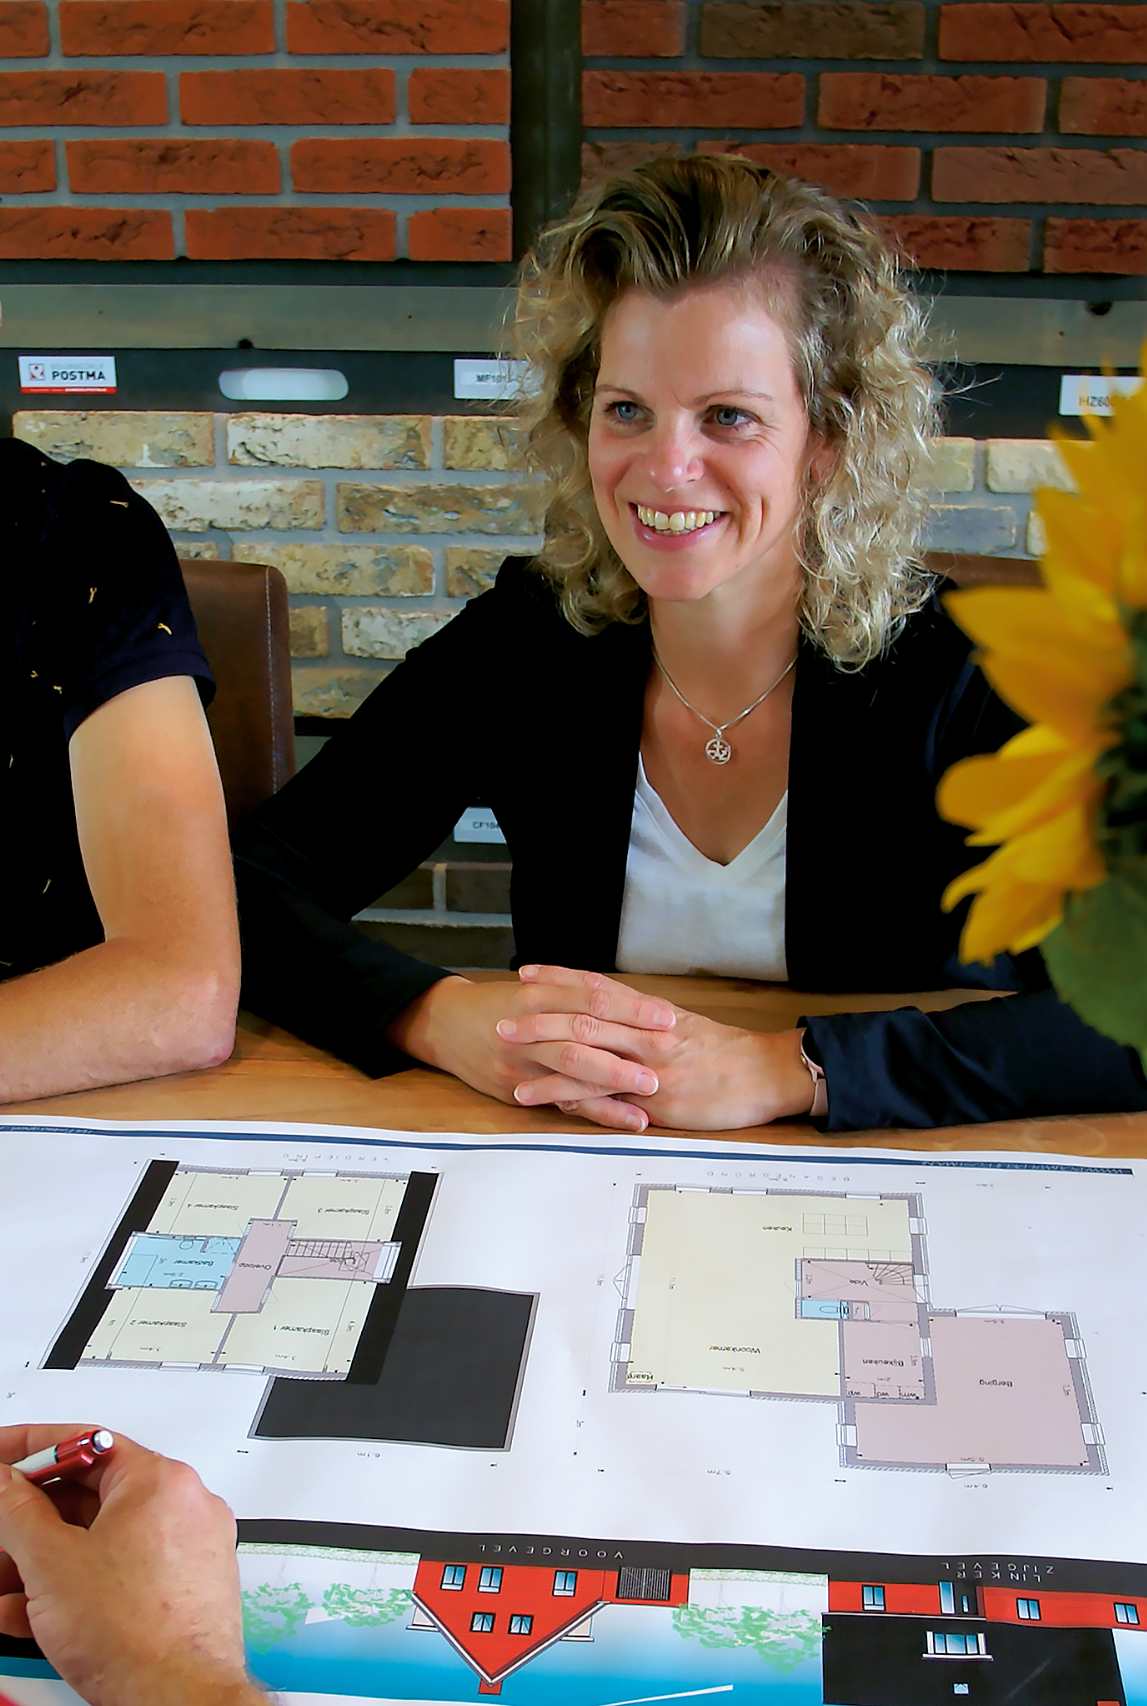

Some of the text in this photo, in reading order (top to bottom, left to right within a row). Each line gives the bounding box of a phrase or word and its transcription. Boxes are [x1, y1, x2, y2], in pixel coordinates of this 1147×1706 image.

[52, 370, 106, 380] POSTMA
[137, 1320, 187, 1328] Slaapkamer
[280, 1325, 330, 1336] Slaapkamer
[709, 1346, 761, 1354] Woonkamer
[863, 1359, 904, 1367] Bijkeuken
[979, 1379, 1013, 1388] Berging
[479, 1544, 623, 1558] VOORGEVEL
[941, 1562, 1053, 1574] ZIJGEVEL
[957, 1570, 1041, 1582] LINKER
